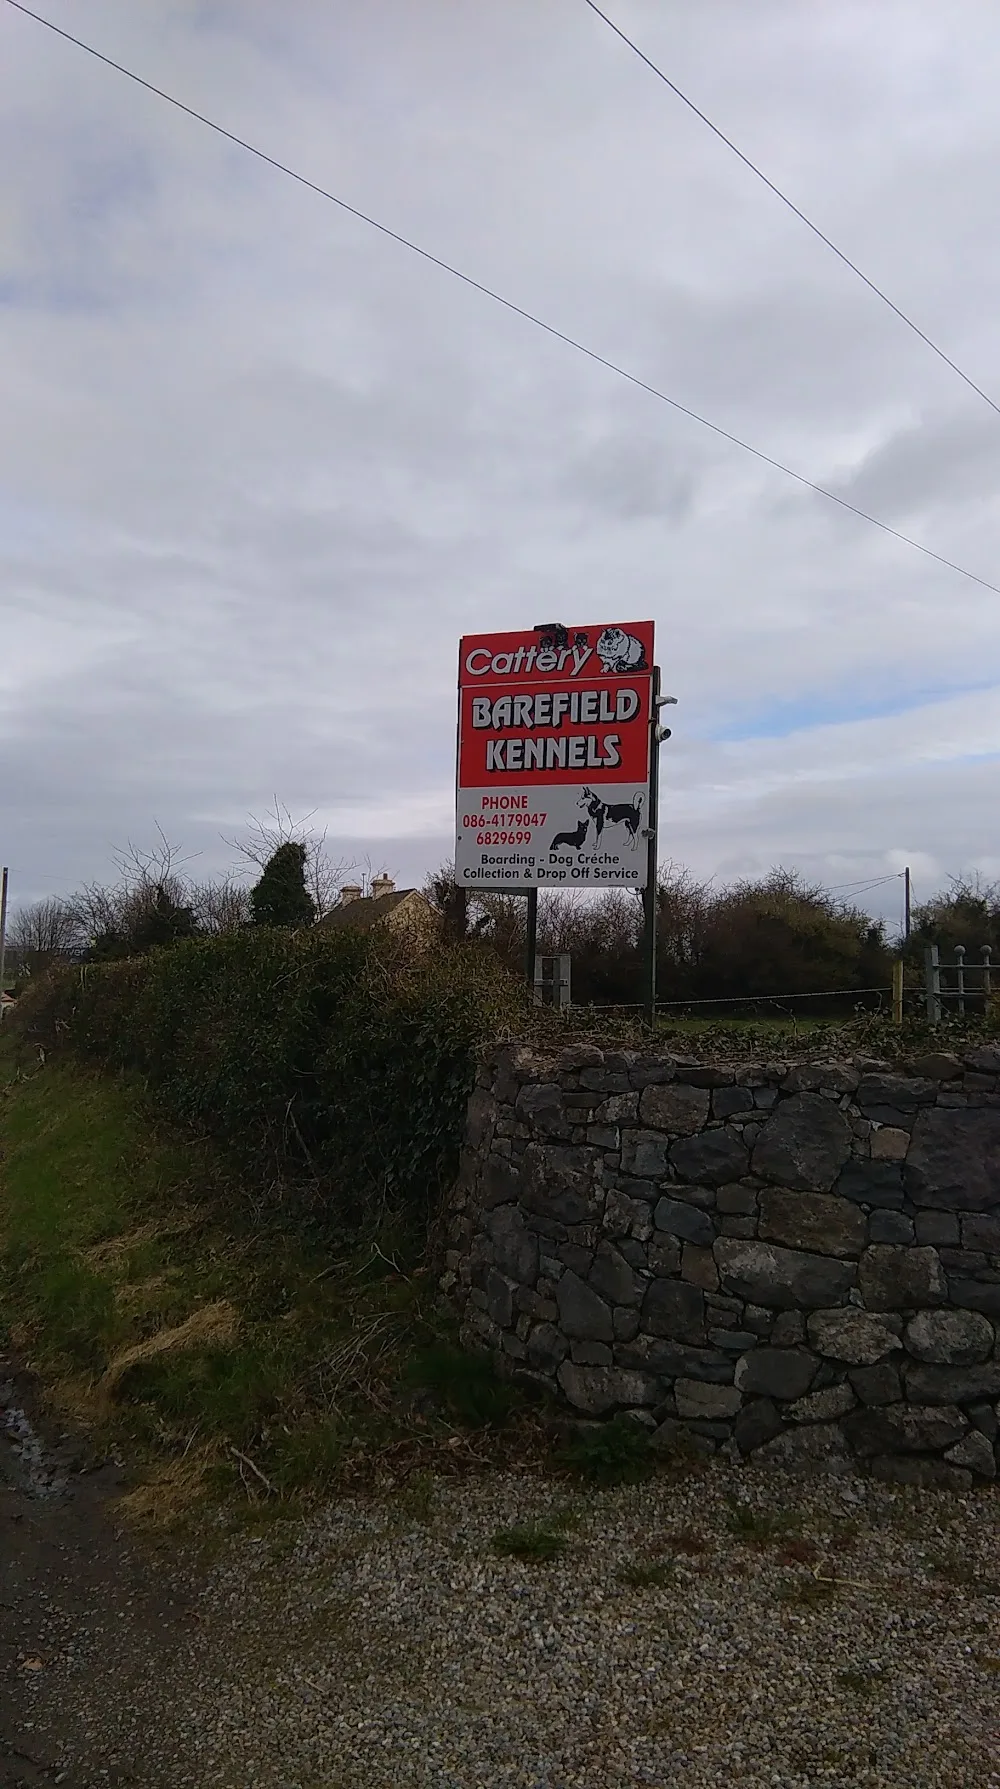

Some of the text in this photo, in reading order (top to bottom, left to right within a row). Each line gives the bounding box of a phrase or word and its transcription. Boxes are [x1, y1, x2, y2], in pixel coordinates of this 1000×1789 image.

[465, 646, 592, 675] Cattery
[472, 689, 641, 730] BAREFIELD
[485, 734, 622, 772] KENNELS
[482, 795, 528, 809] PHONE
[463, 813, 547, 828] 086-4179047
[476, 831, 531, 845] 6829699
[481, 854, 536, 867] Boarding
[549, 853, 573, 866] Dog
[463, 867, 639, 881] Collection & Drop Off Service
